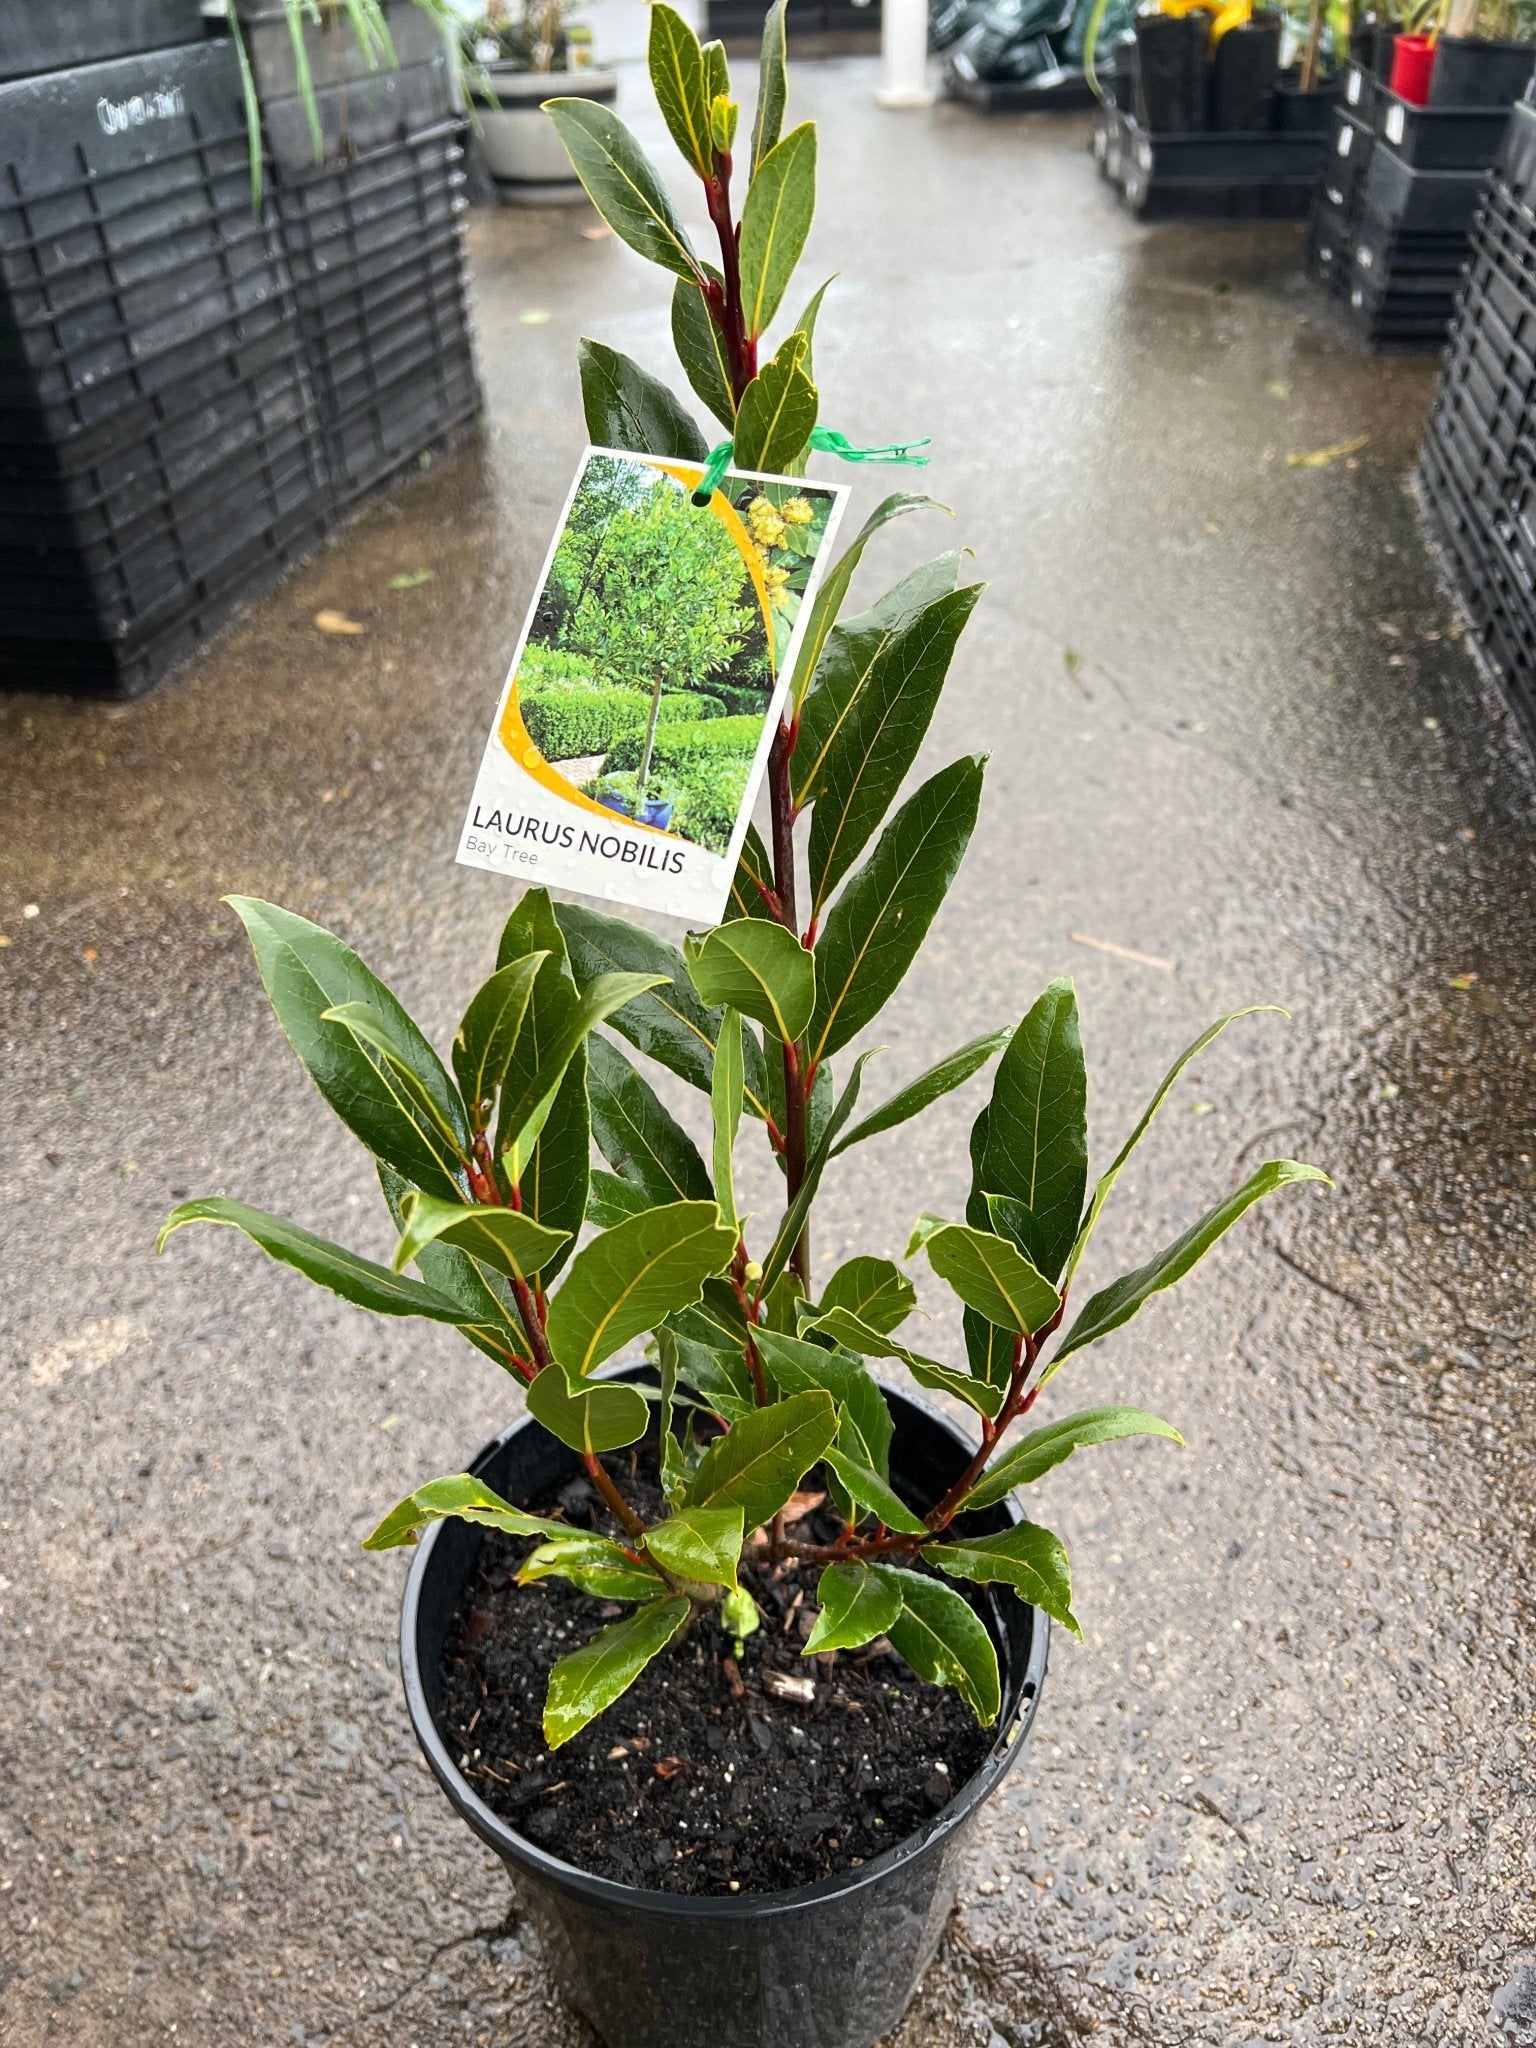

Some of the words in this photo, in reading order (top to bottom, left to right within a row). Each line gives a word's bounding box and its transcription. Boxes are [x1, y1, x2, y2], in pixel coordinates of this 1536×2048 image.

[466, 835, 496, 858] Bay
[503, 844, 538, 865] Tree
[472, 806, 576, 848] LAURUS
[578, 830, 686, 874] NOBILIS
